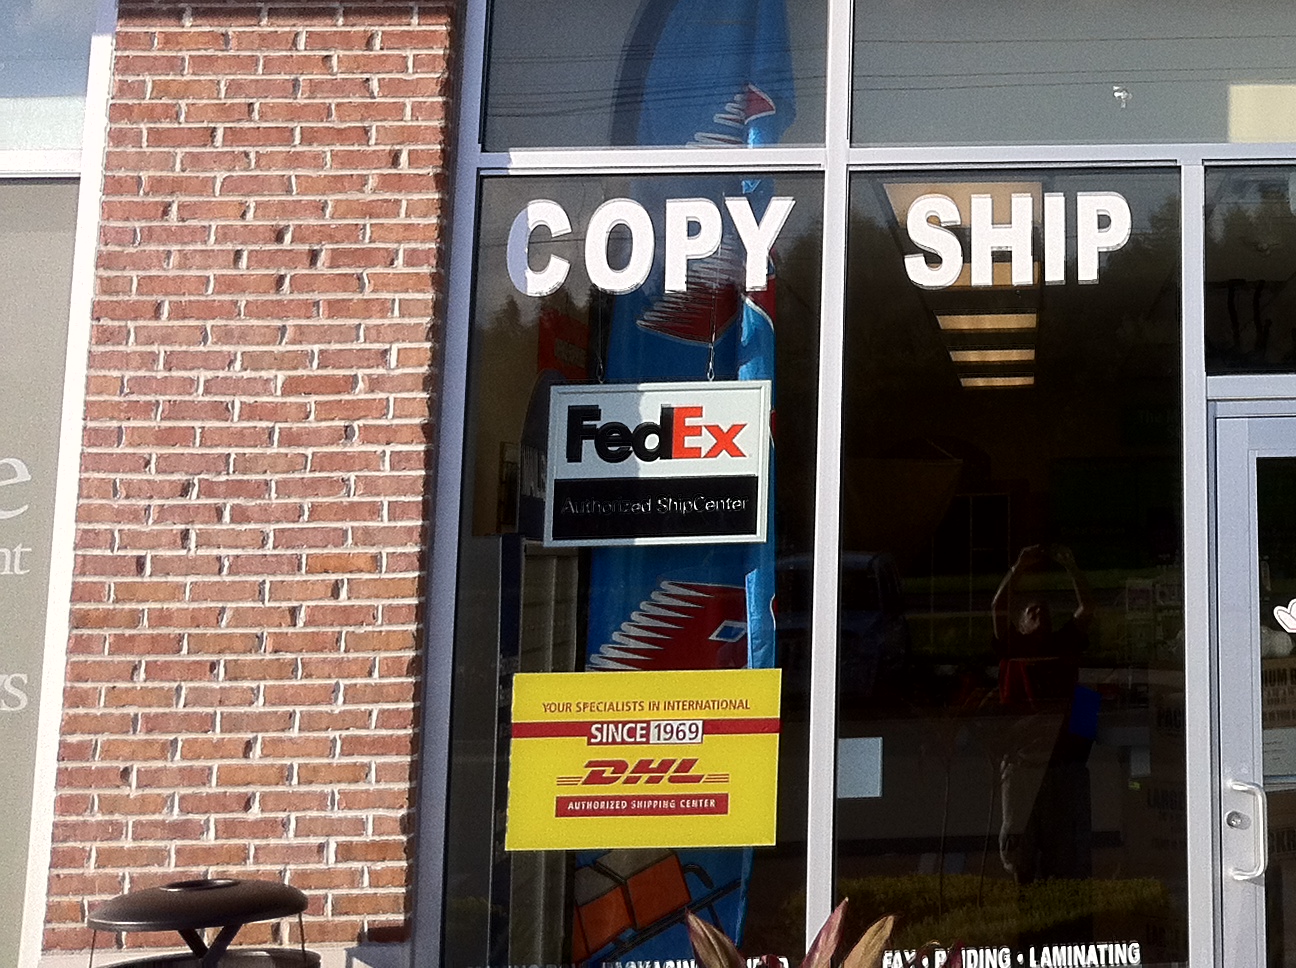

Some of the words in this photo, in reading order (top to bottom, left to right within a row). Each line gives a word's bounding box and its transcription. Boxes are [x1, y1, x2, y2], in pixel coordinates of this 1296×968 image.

[506, 197, 797, 297] COPY
[902, 192, 1133, 290] SHIP
[565, 404, 748, 463] FedEx
[560, 496, 651, 514] Authorized
[541, 701, 573, 714] YOUR
[575, 700, 645, 713] SPECIALISTS
[648, 700, 661, 712] IN
[663, 698, 751, 711] INTERNATIONAL
[589, 722, 648, 744] SINCE
[653, 721, 701, 742] 1969
[580, 757, 707, 786] DHL
[567, 800, 628, 811] AUTHORIZED
[630, 799, 677, 809] SHIPPING
[679, 798, 717, 809] CENTER
[1029, 941, 1141, 968] LAMINATING
